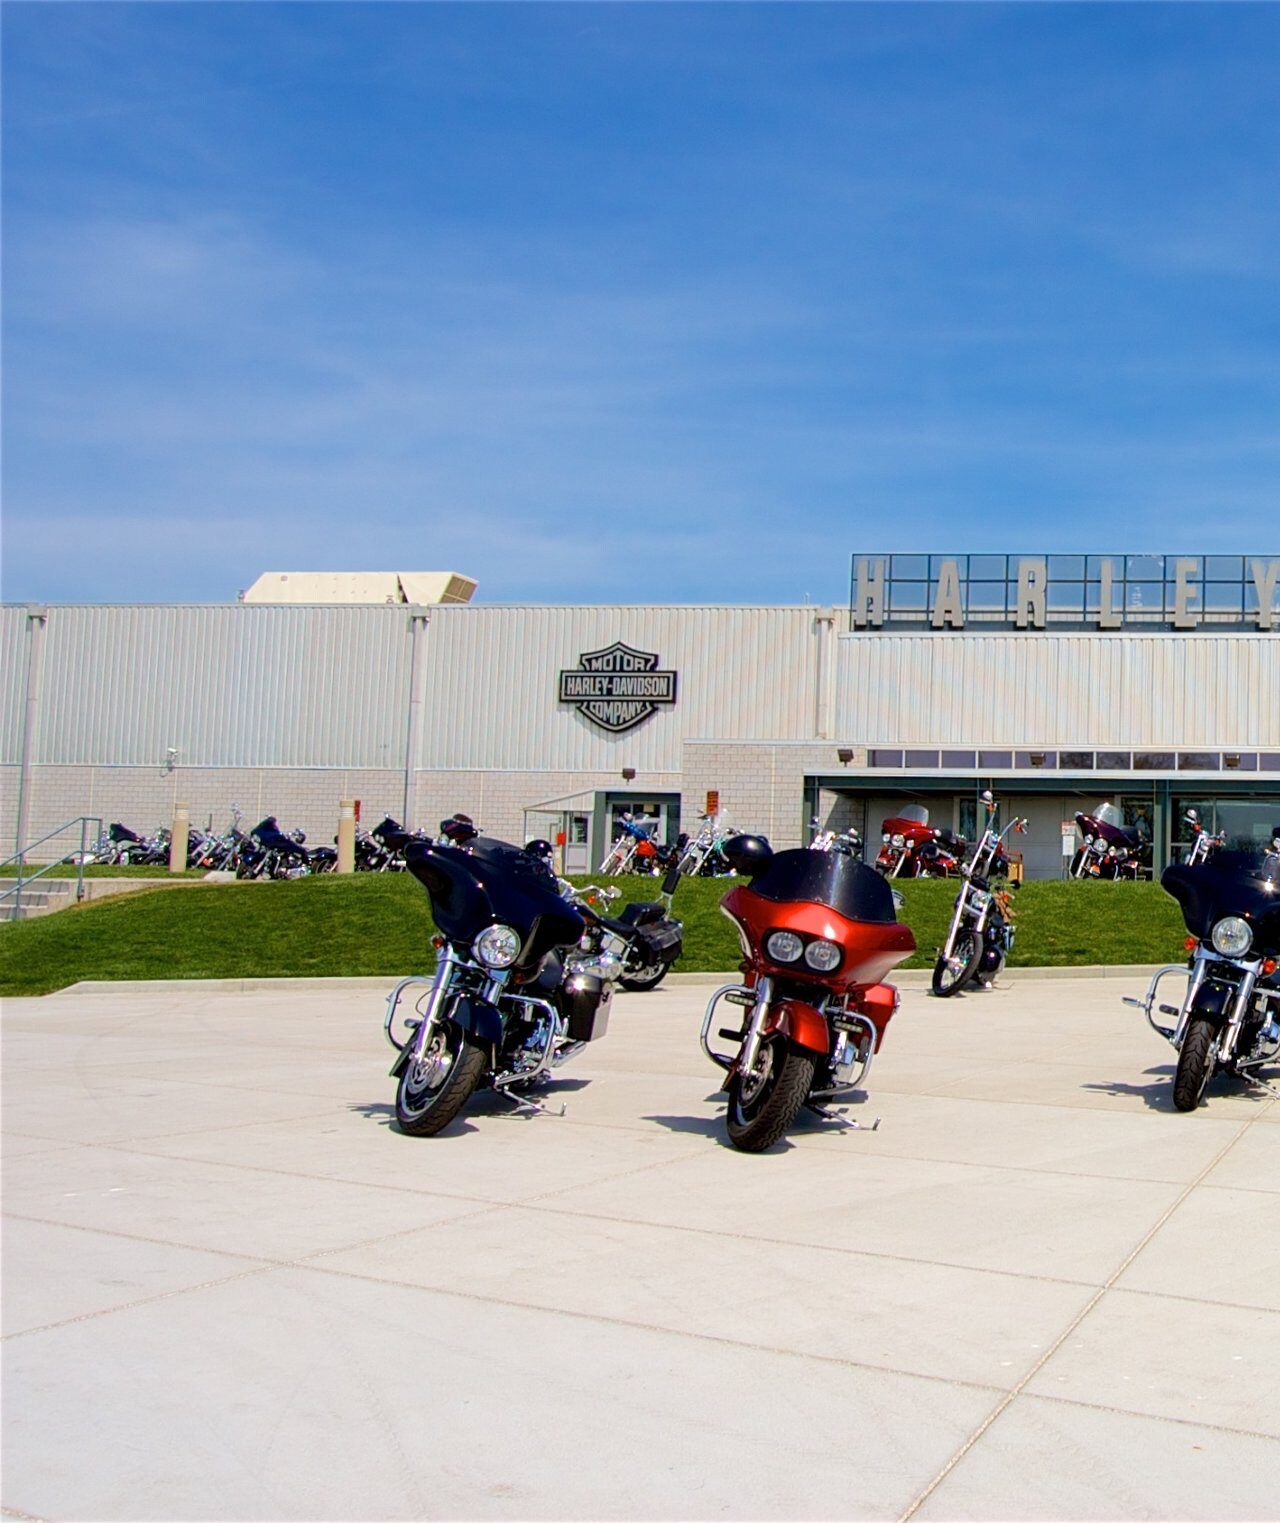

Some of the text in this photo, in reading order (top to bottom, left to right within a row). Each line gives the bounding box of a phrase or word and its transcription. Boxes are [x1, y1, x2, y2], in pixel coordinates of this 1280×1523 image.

[591, 650, 646, 671] MOTOR
[566, 676, 669, 696] HARLEY-DAVIDSON
[589, 701, 643, 725] COMPANY
